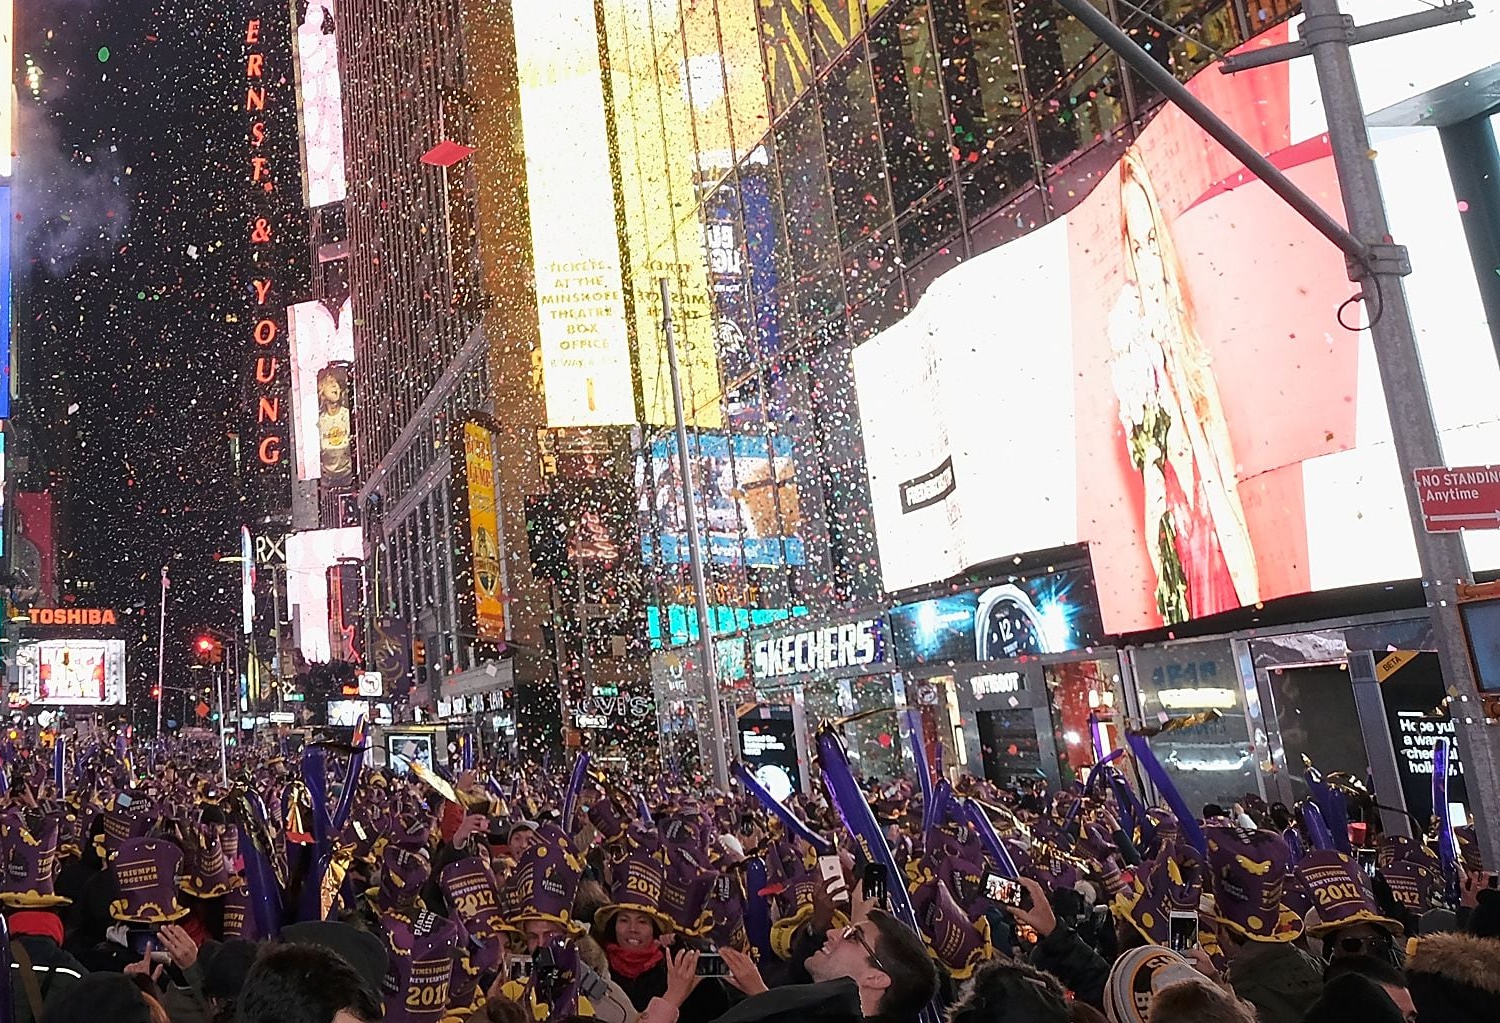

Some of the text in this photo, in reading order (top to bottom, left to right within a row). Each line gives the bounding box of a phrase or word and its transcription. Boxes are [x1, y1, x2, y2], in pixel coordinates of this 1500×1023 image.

[245, 18, 280, 466] ERNST & YOUNG
[551, 260, 606, 274] TICKETS
[555, 279, 570, 289] AT
[566, 323, 599, 335] BOX
[1422, 470, 1500, 488] NO STANDIN
[1426, 487, 1480, 503] Anytime
[27, 608, 117, 625] TOSHIBA
[754, 619, 878, 677] SKECHERS
[1383, 654, 1402, 673] BETA
[1404, 736, 1412, 746] a
[117, 865, 158, 878] TRIUMPH
[119, 874, 159, 885] TOGETHER
[627, 876, 661, 902] 2017
[1314, 883, 1361, 906] 2017
[454, 890, 496, 914] 2017
